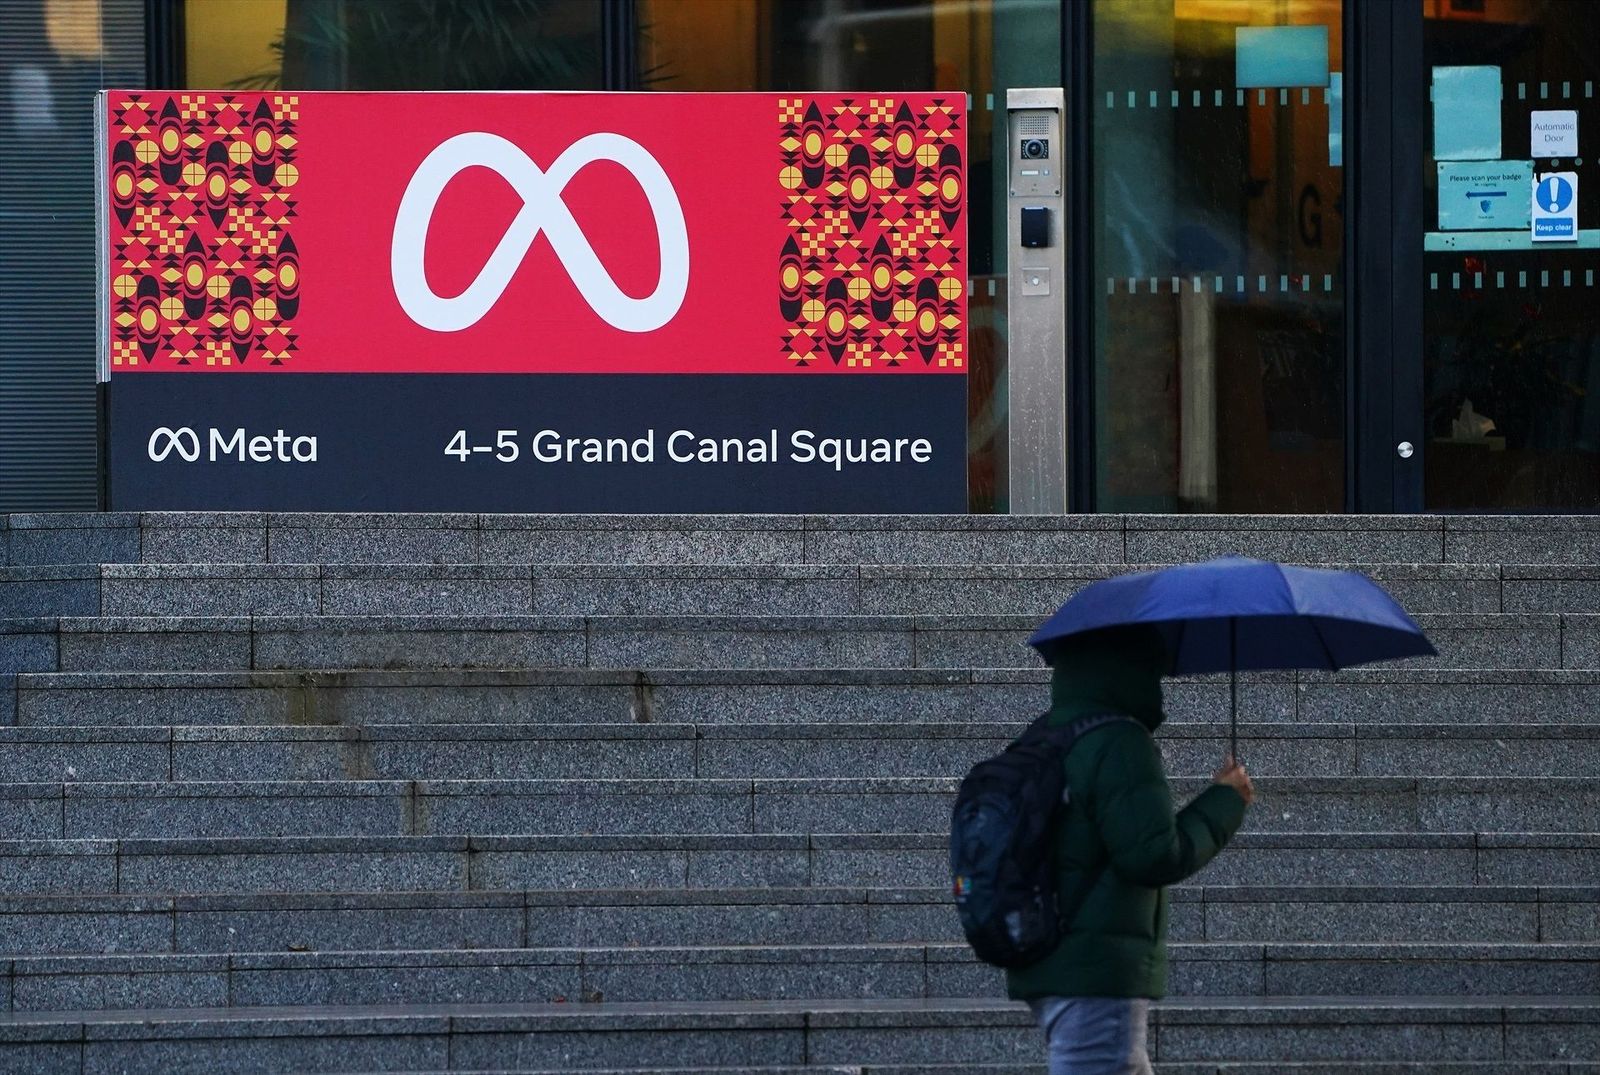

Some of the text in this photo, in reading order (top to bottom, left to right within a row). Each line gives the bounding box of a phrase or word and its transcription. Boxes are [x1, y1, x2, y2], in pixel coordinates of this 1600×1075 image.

[1534, 123, 1575, 131] Automatic
[1544, 134, 1564, 142] Door
[1486, 174, 1501, 182] your
[1502, 173, 1522, 181] badge
[1536, 224, 1554, 232] Keep
[209, 427, 318, 463] Meta
[532, 429, 654, 463] Grand
[667, 429, 778, 463] Canal
[790, 429, 933, 471] Square
